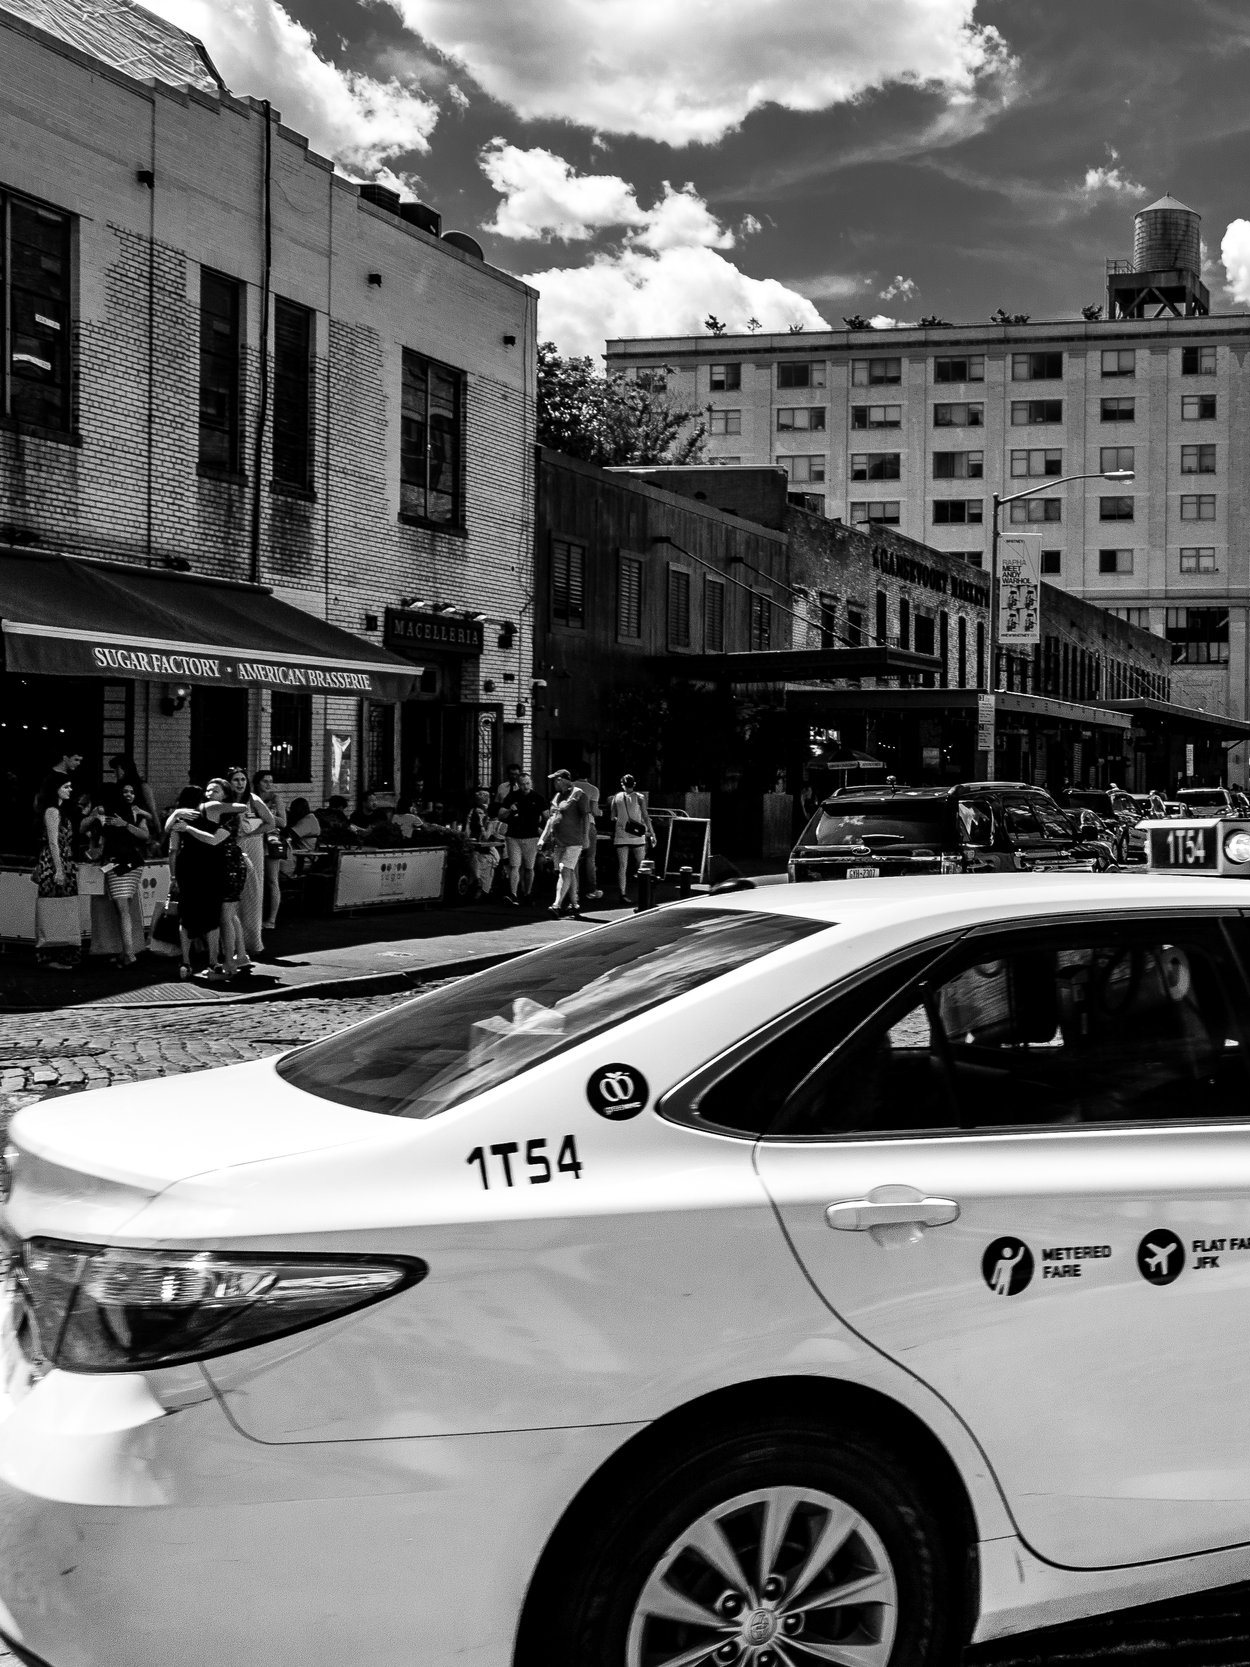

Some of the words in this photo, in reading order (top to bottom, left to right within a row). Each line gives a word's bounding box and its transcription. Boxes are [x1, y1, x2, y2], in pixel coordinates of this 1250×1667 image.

[394, 619, 479, 645] MACELLERIA
[93, 647, 151, 673] SUGAR
[152, 653, 221, 678] FACTORY
[238, 663, 307, 686] AMERICAN
[308, 670, 373, 690] BRASSERIE
[1167, 829, 1206, 864] 1T54
[466, 1134, 583, 1190] 1T54
[1042, 1245, 1112, 1261] METERED
[1192, 1238, 1227, 1253] FLAT
[1043, 1264, 1082, 1279] FARE
[1192, 1256, 1220, 1270] JFK
